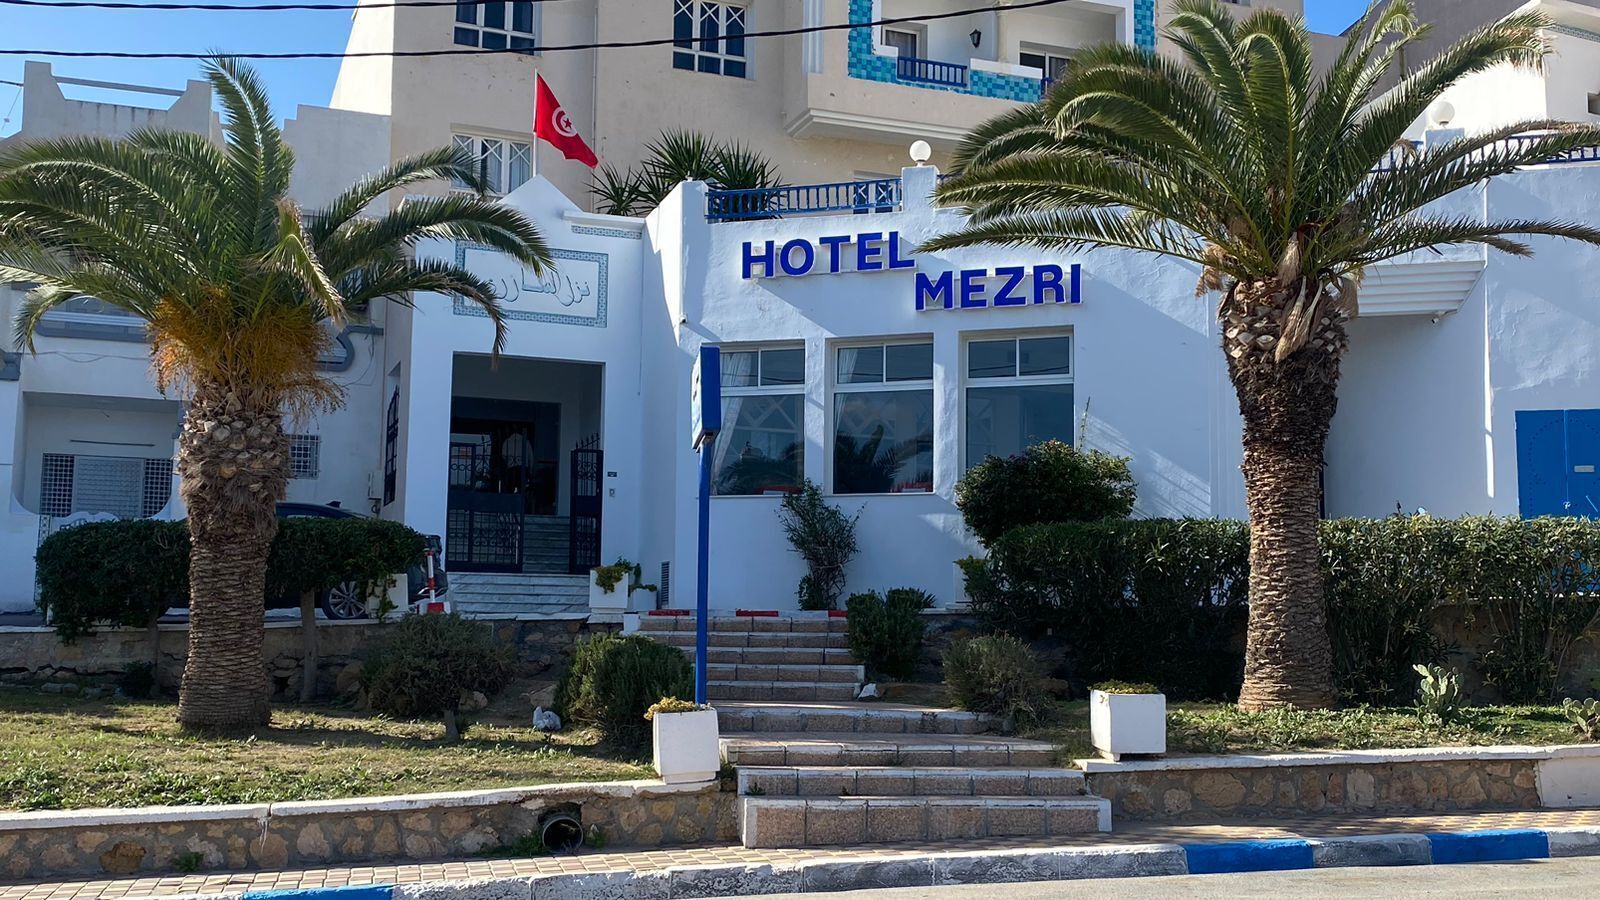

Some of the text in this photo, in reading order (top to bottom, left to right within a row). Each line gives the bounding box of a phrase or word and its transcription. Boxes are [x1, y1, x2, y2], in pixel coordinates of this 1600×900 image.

[742, 231, 915, 279] HOTEL
[555, 274, 591, 307] نزل
[916, 264, 1082, 311] MEZRI
